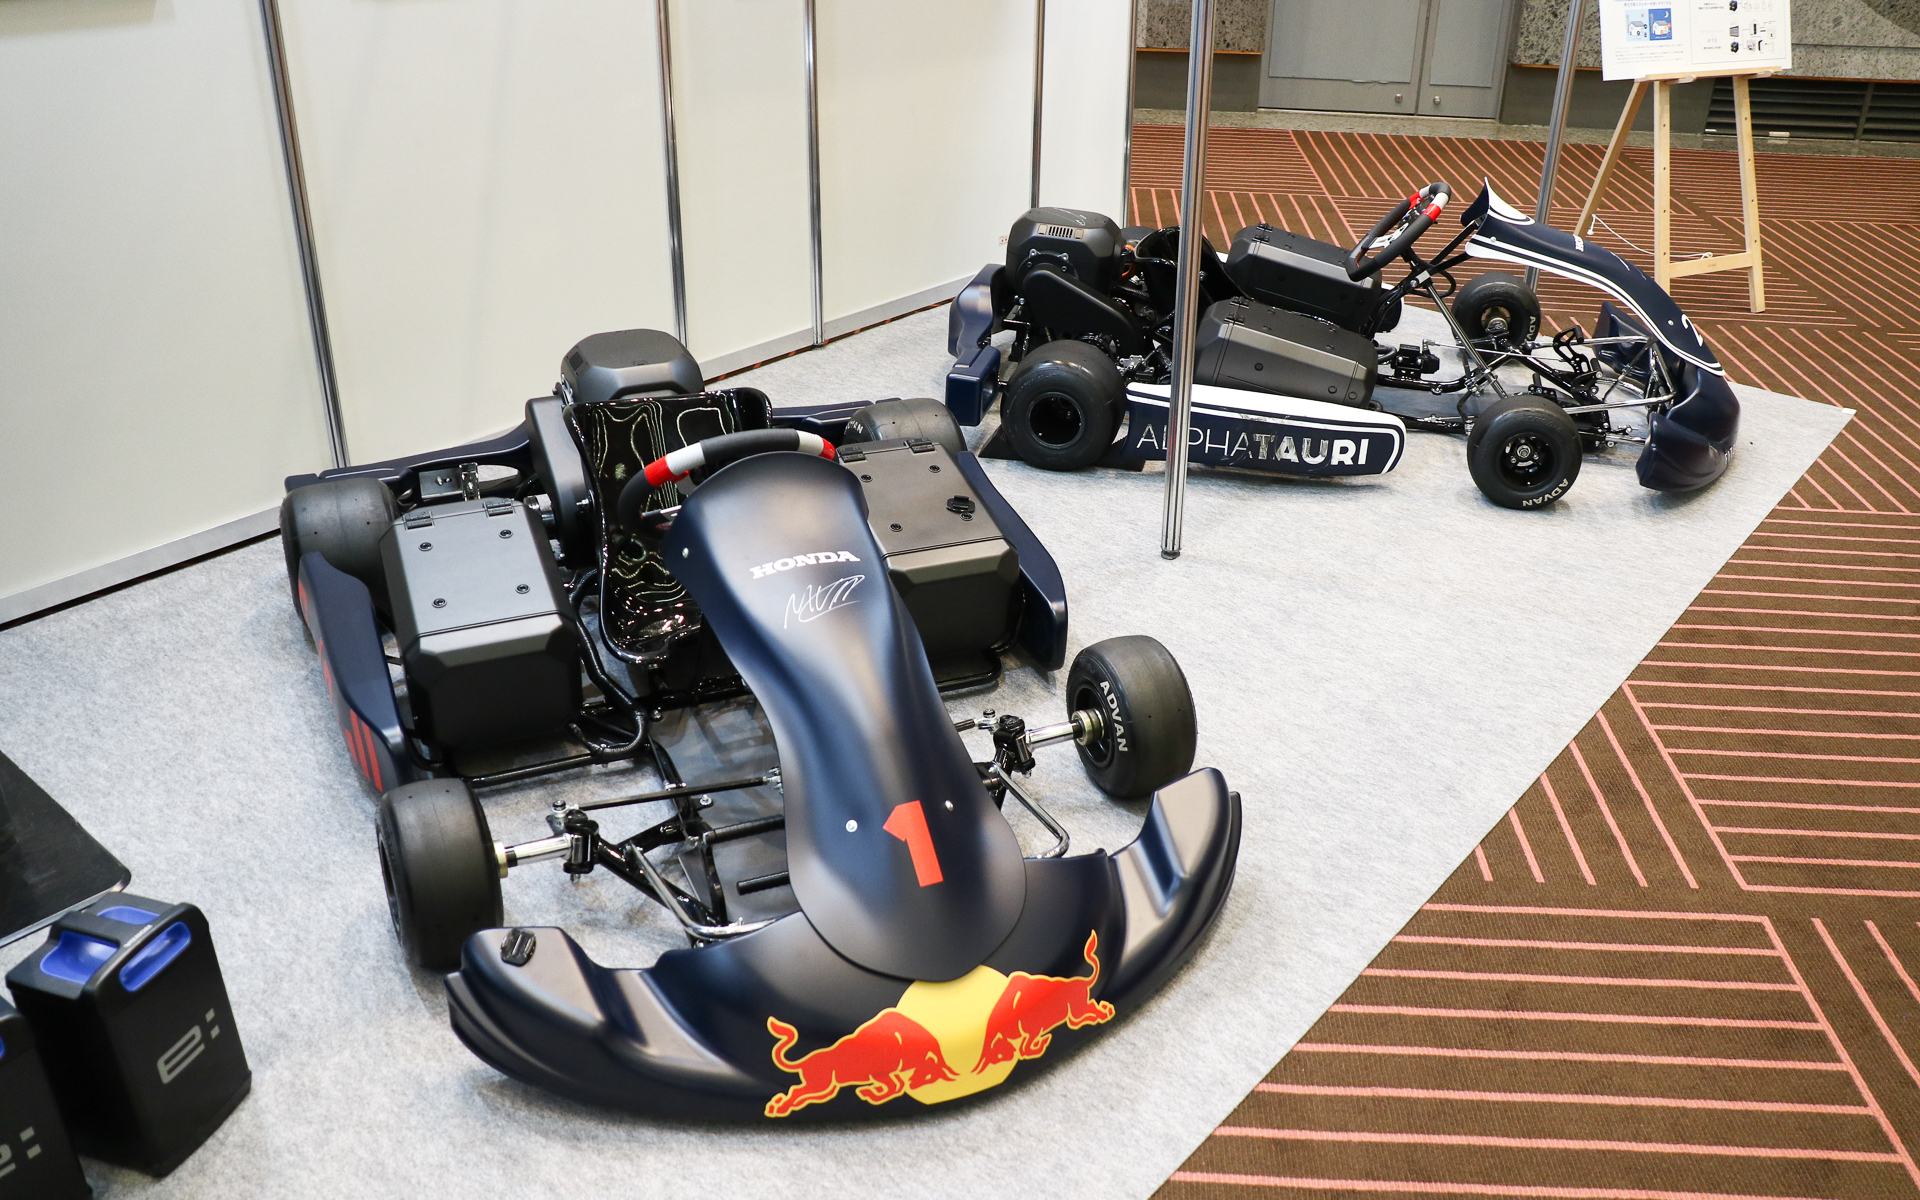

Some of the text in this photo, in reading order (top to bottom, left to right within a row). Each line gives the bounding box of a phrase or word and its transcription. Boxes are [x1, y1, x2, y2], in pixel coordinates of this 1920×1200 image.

[1681, 313, 1704, 347] 2
[1522, 478, 1569, 506] ADVAN
[749, 550, 861, 580] HONDA
[1099, 680, 1130, 752] ADVAN
[882, 799, 944, 888] 1
